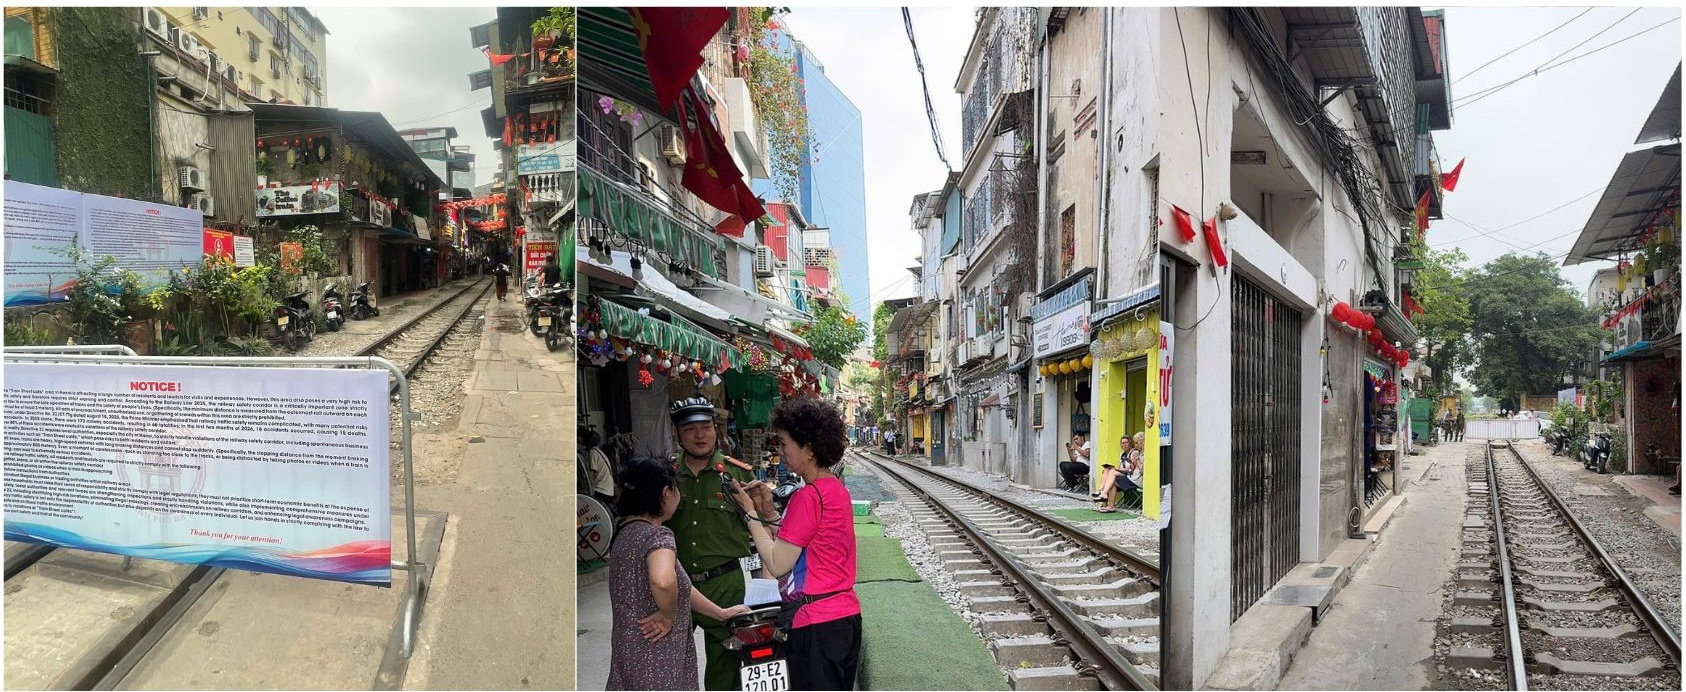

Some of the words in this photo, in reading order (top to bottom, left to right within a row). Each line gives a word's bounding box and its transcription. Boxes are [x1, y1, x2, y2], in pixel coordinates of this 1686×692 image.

[130, 381, 176, 391] NOTICE
[190, 529, 210, 537] Thank
[211, 532, 222, 540] you
[223, 532, 233, 540] for
[250, 534, 282, 544] attention!
[747, 662, 781, 681] 29-E2
